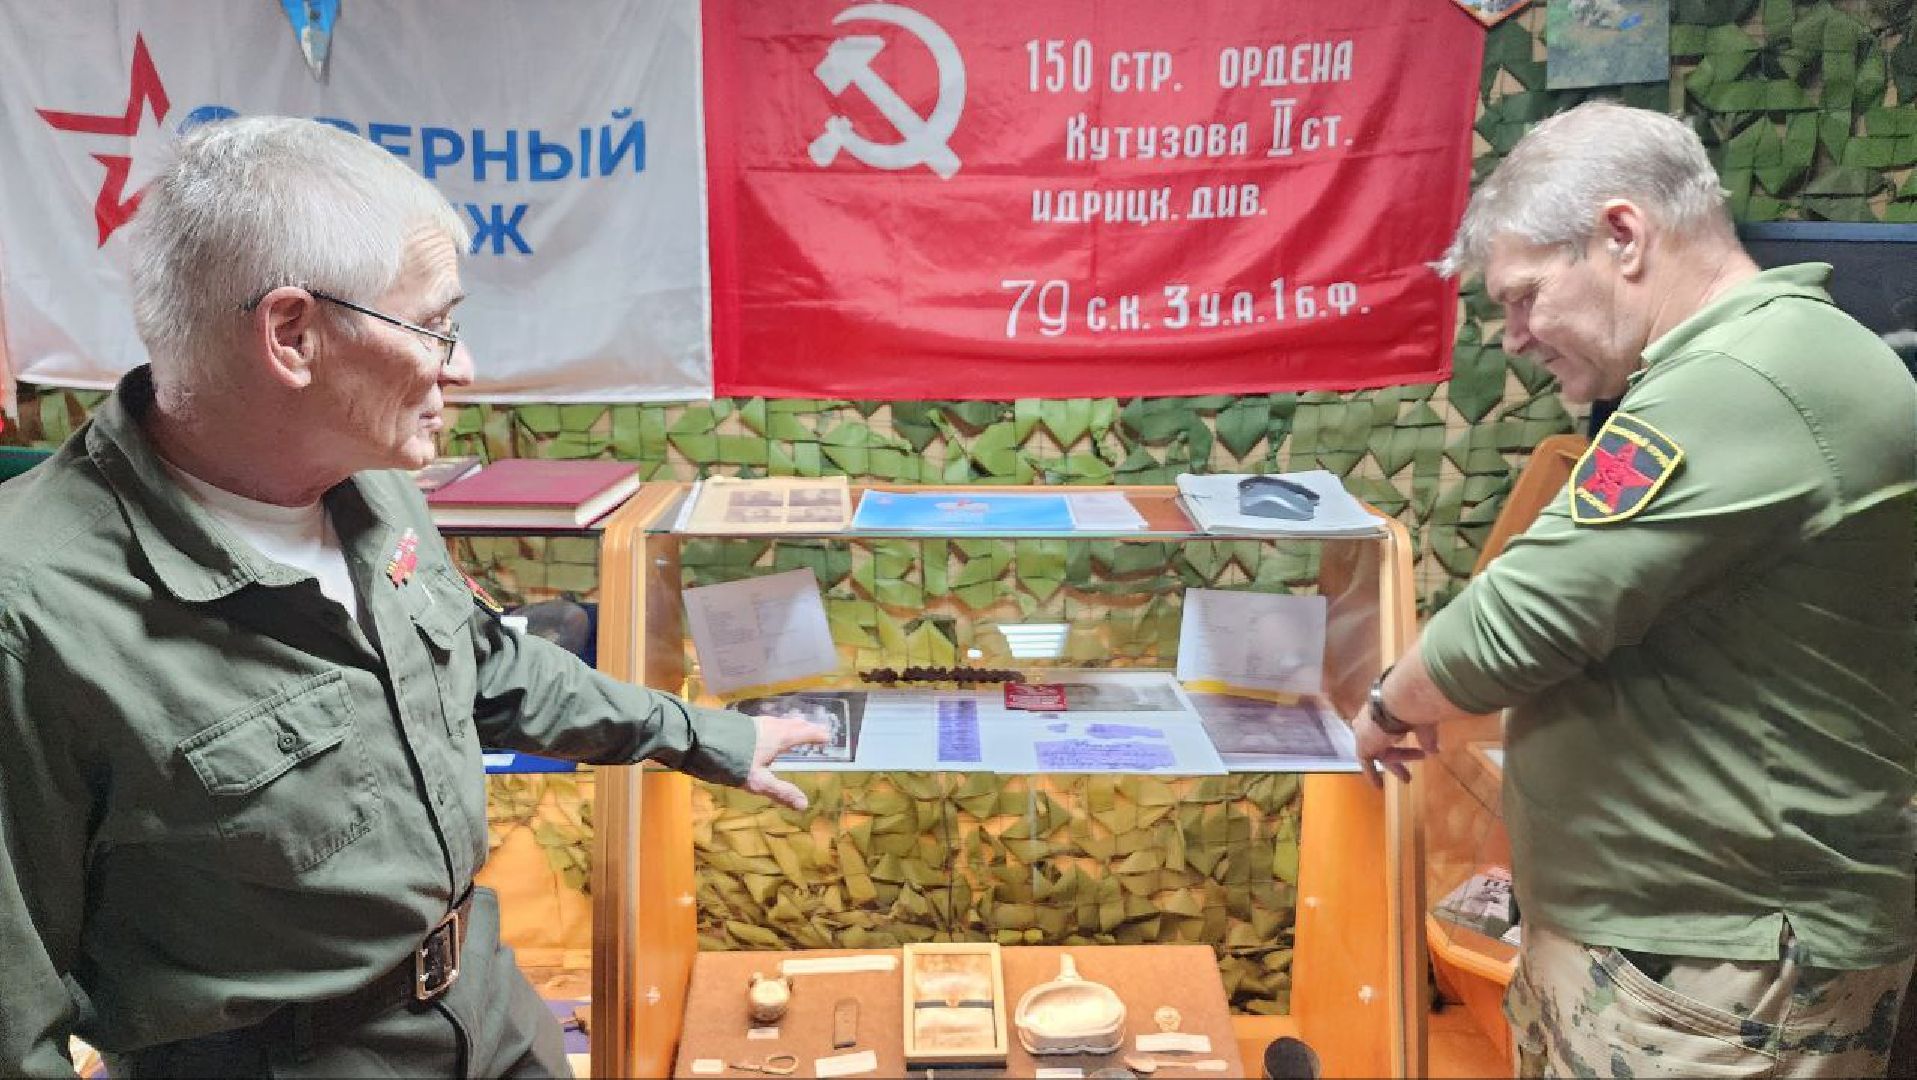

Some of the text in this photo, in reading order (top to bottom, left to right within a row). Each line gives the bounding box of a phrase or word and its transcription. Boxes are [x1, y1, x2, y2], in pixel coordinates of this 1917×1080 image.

[1026, 38, 1094, 93] 150
[1218, 39, 1354, 89] ОРДЕНА
[1001, 279, 1070, 339] 79
